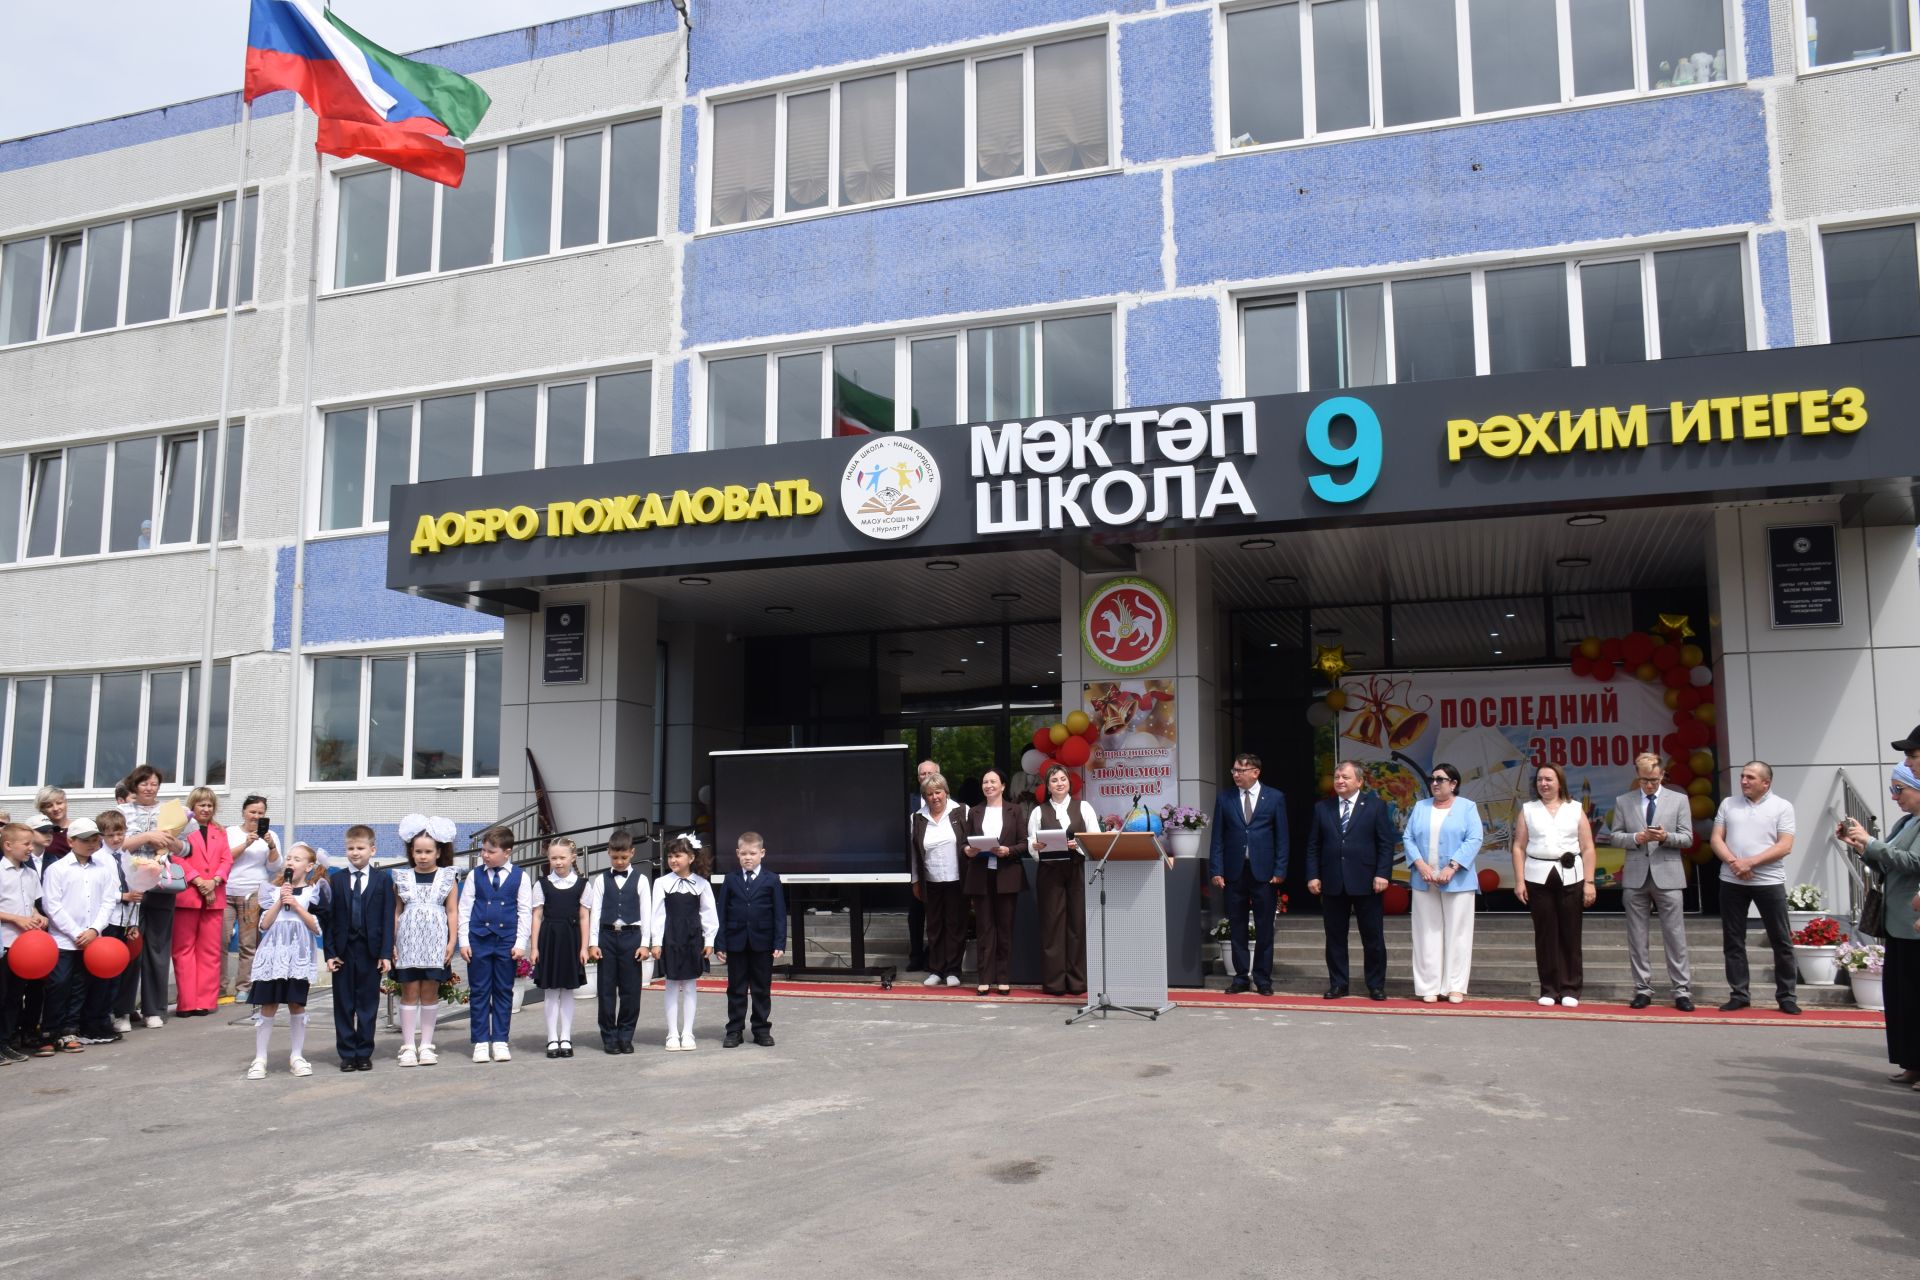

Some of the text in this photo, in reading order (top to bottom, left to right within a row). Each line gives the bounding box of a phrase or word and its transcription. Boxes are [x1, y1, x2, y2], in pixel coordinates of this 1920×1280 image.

[970, 401, 1258, 477] МӘКТӘП
[1670, 386, 1868, 445] ИТЕГЕЗ
[846, 460, 859, 481] НАША
[860, 442, 884, 459] ШКОЛА
[893, 441, 914, 452] НАША
[913, 449, 935, 483] ГОРДОСТЬ
[1305, 396, 1383, 503] 9
[410, 478, 823, 554] ДОБРО ПОЖАЛОВАТЬ
[976, 461, 1258, 535] ШКОЛА
[1440, 686, 1619, 731] ПОСЛЕДНИЙ
[1092, 763, 1171, 779] любимая
[1099, 780, 1162, 796] школа!
